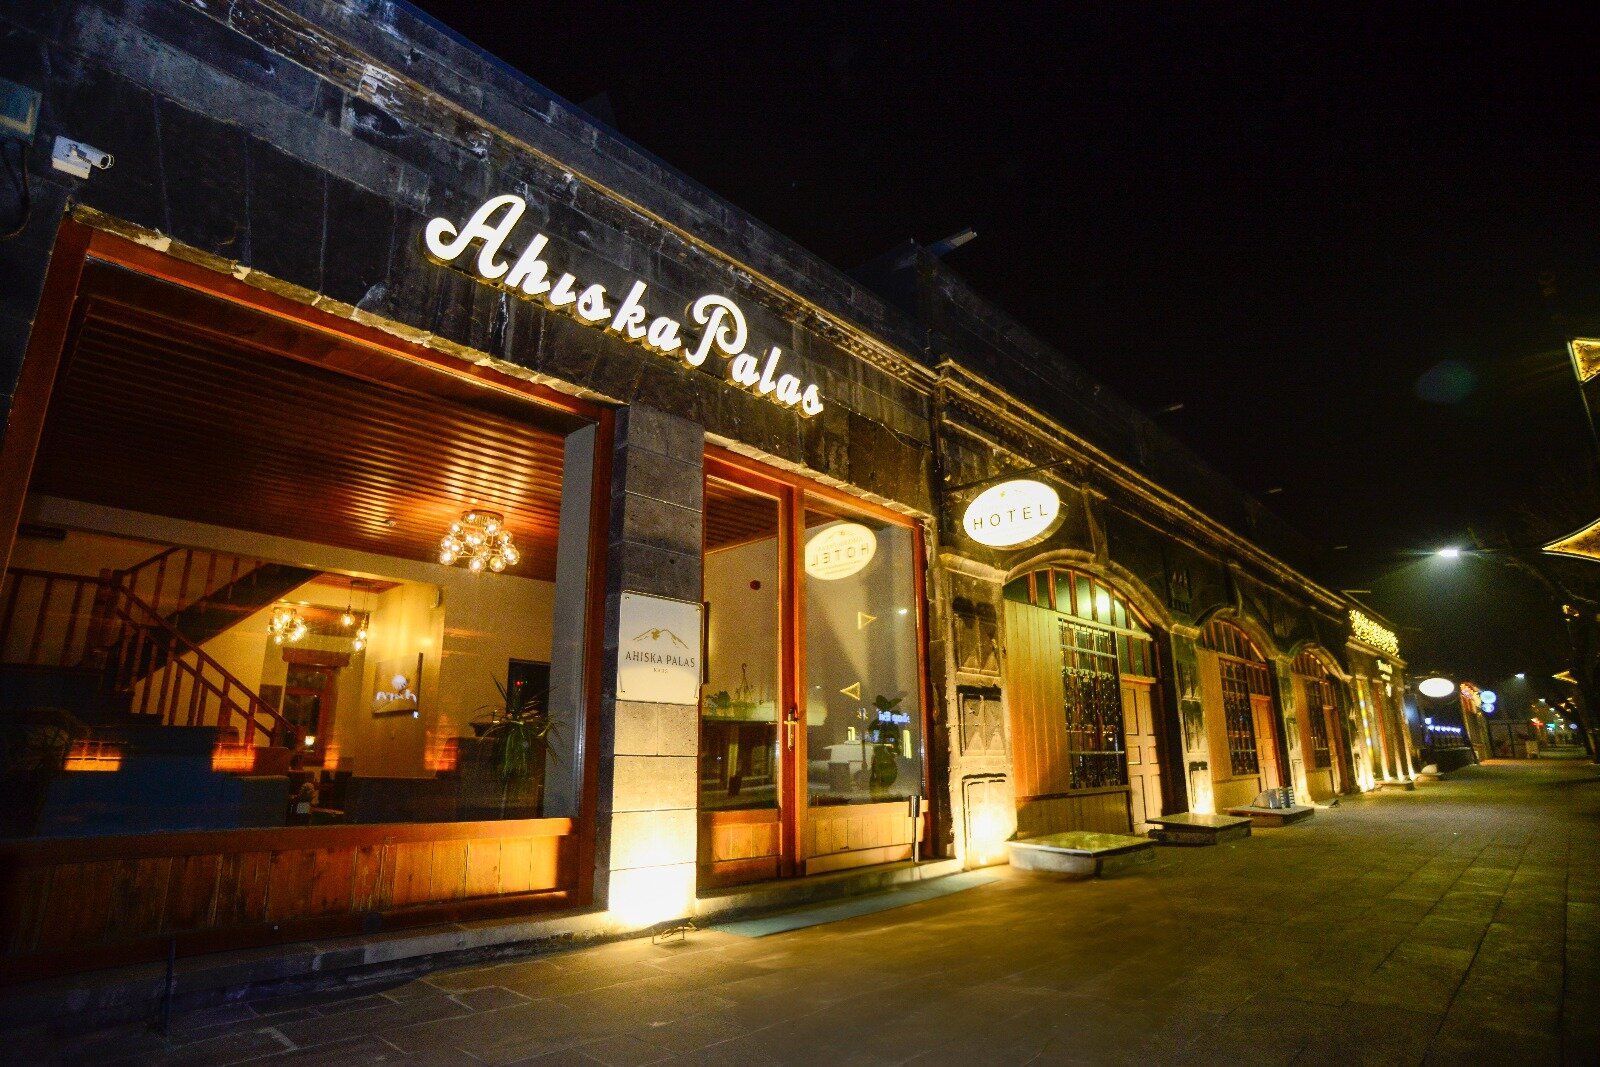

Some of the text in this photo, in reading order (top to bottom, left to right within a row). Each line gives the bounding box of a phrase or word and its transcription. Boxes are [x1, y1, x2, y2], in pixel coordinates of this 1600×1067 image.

[686, 294, 823, 416] Palas
[973, 504, 1048, 530] HOTEL
[625, 650, 695, 668] AHISKA PALAS
